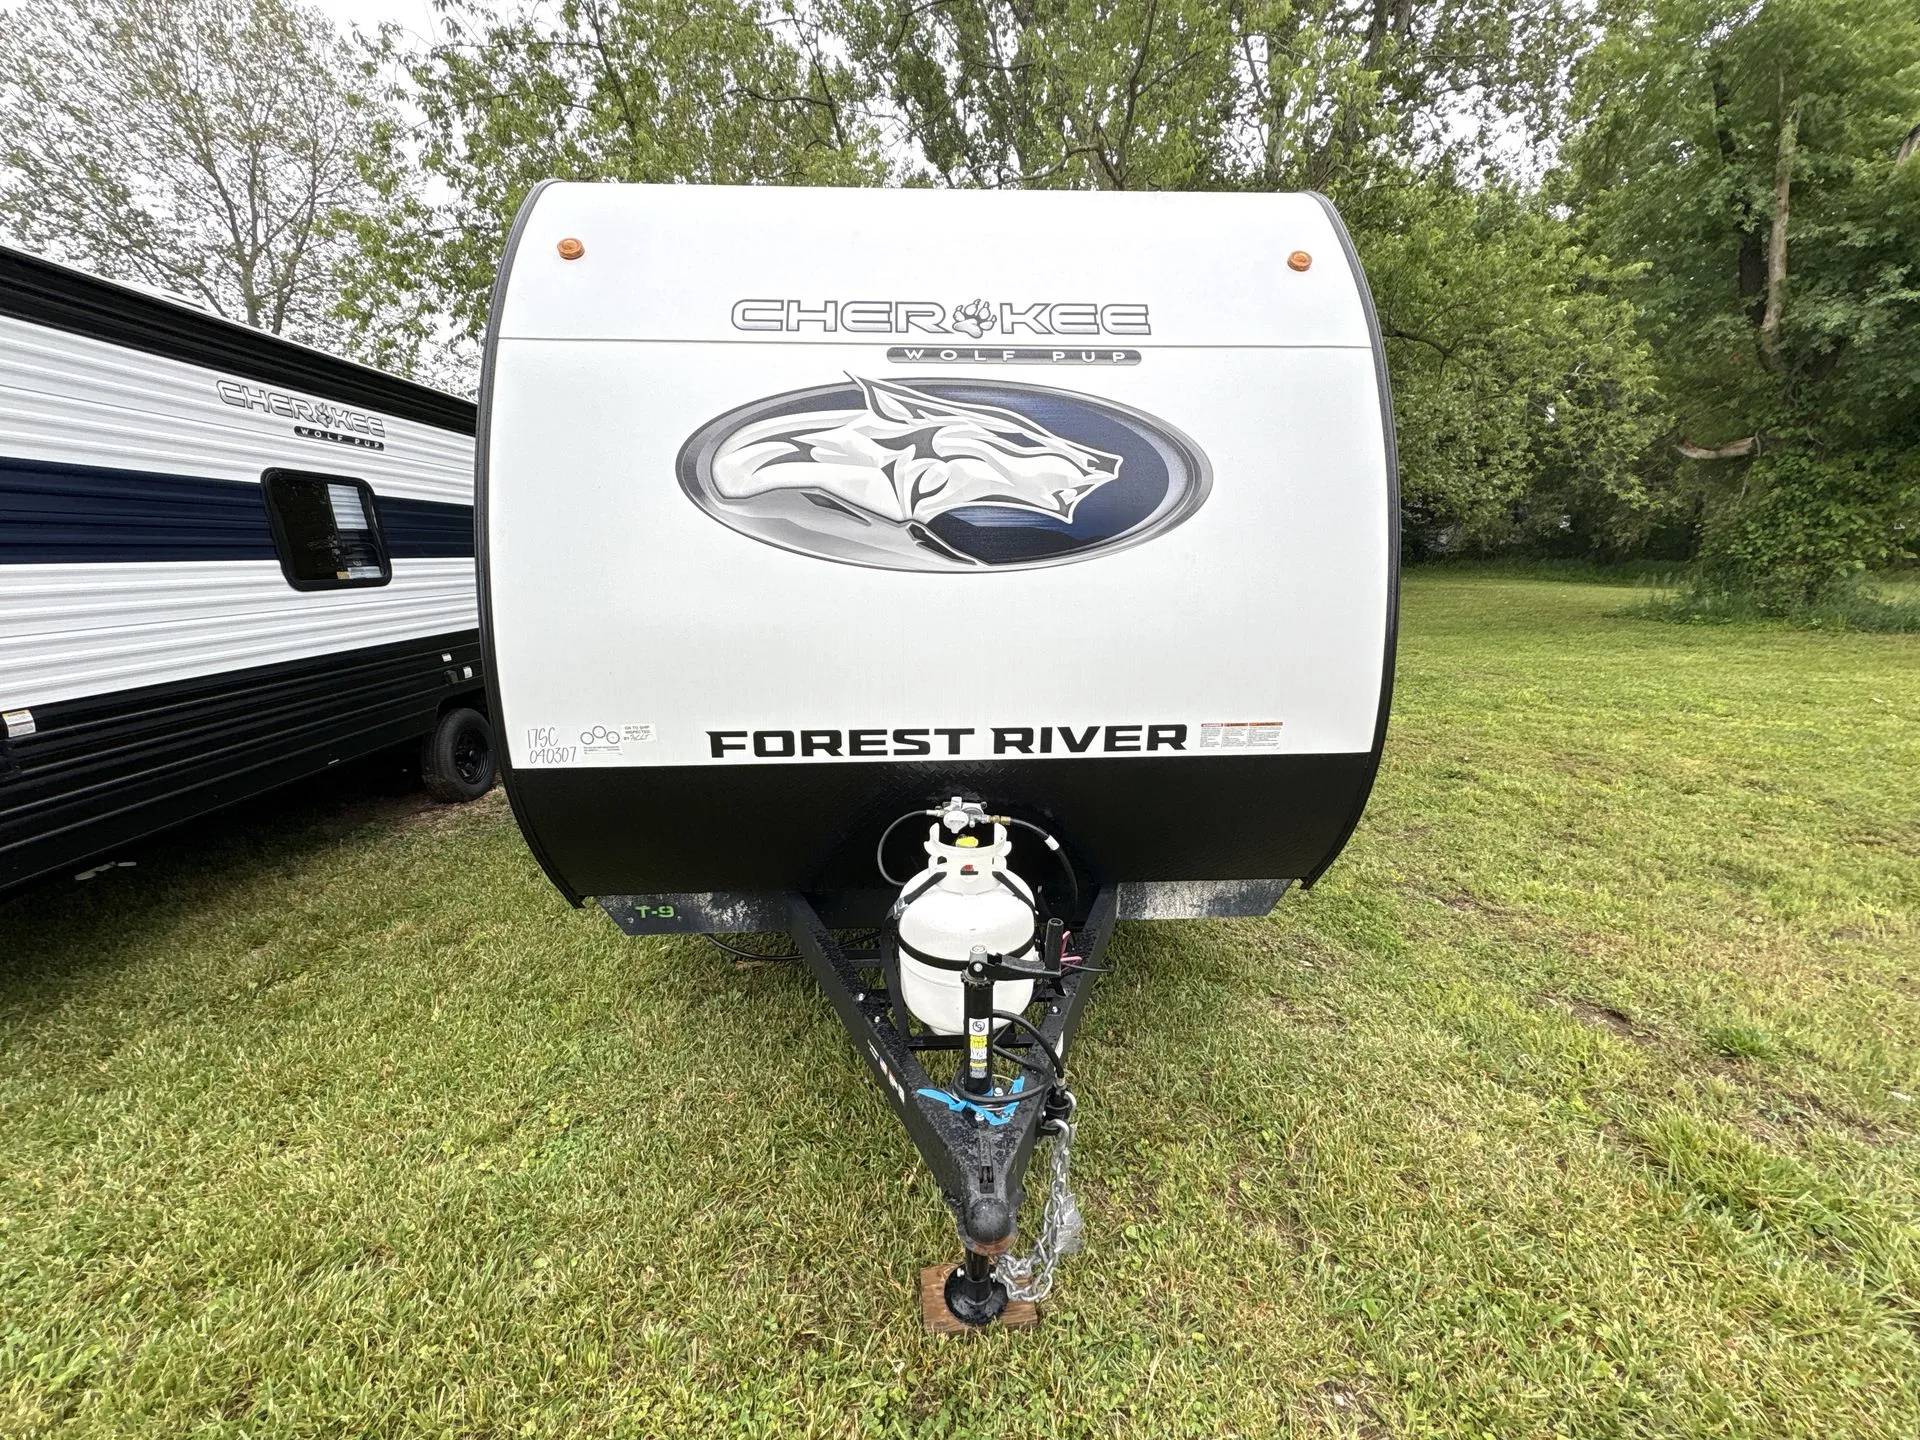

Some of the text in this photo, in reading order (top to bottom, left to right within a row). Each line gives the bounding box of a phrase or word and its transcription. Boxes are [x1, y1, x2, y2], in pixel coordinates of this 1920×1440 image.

[904, 348, 1126, 363] WOLF PUP
[300, 427, 380, 449] WOLF PUP
[705, 728, 975, 758] FOREST
[990, 724, 1188, 754] RIVER
[635, 905, 675, 918] T-9
